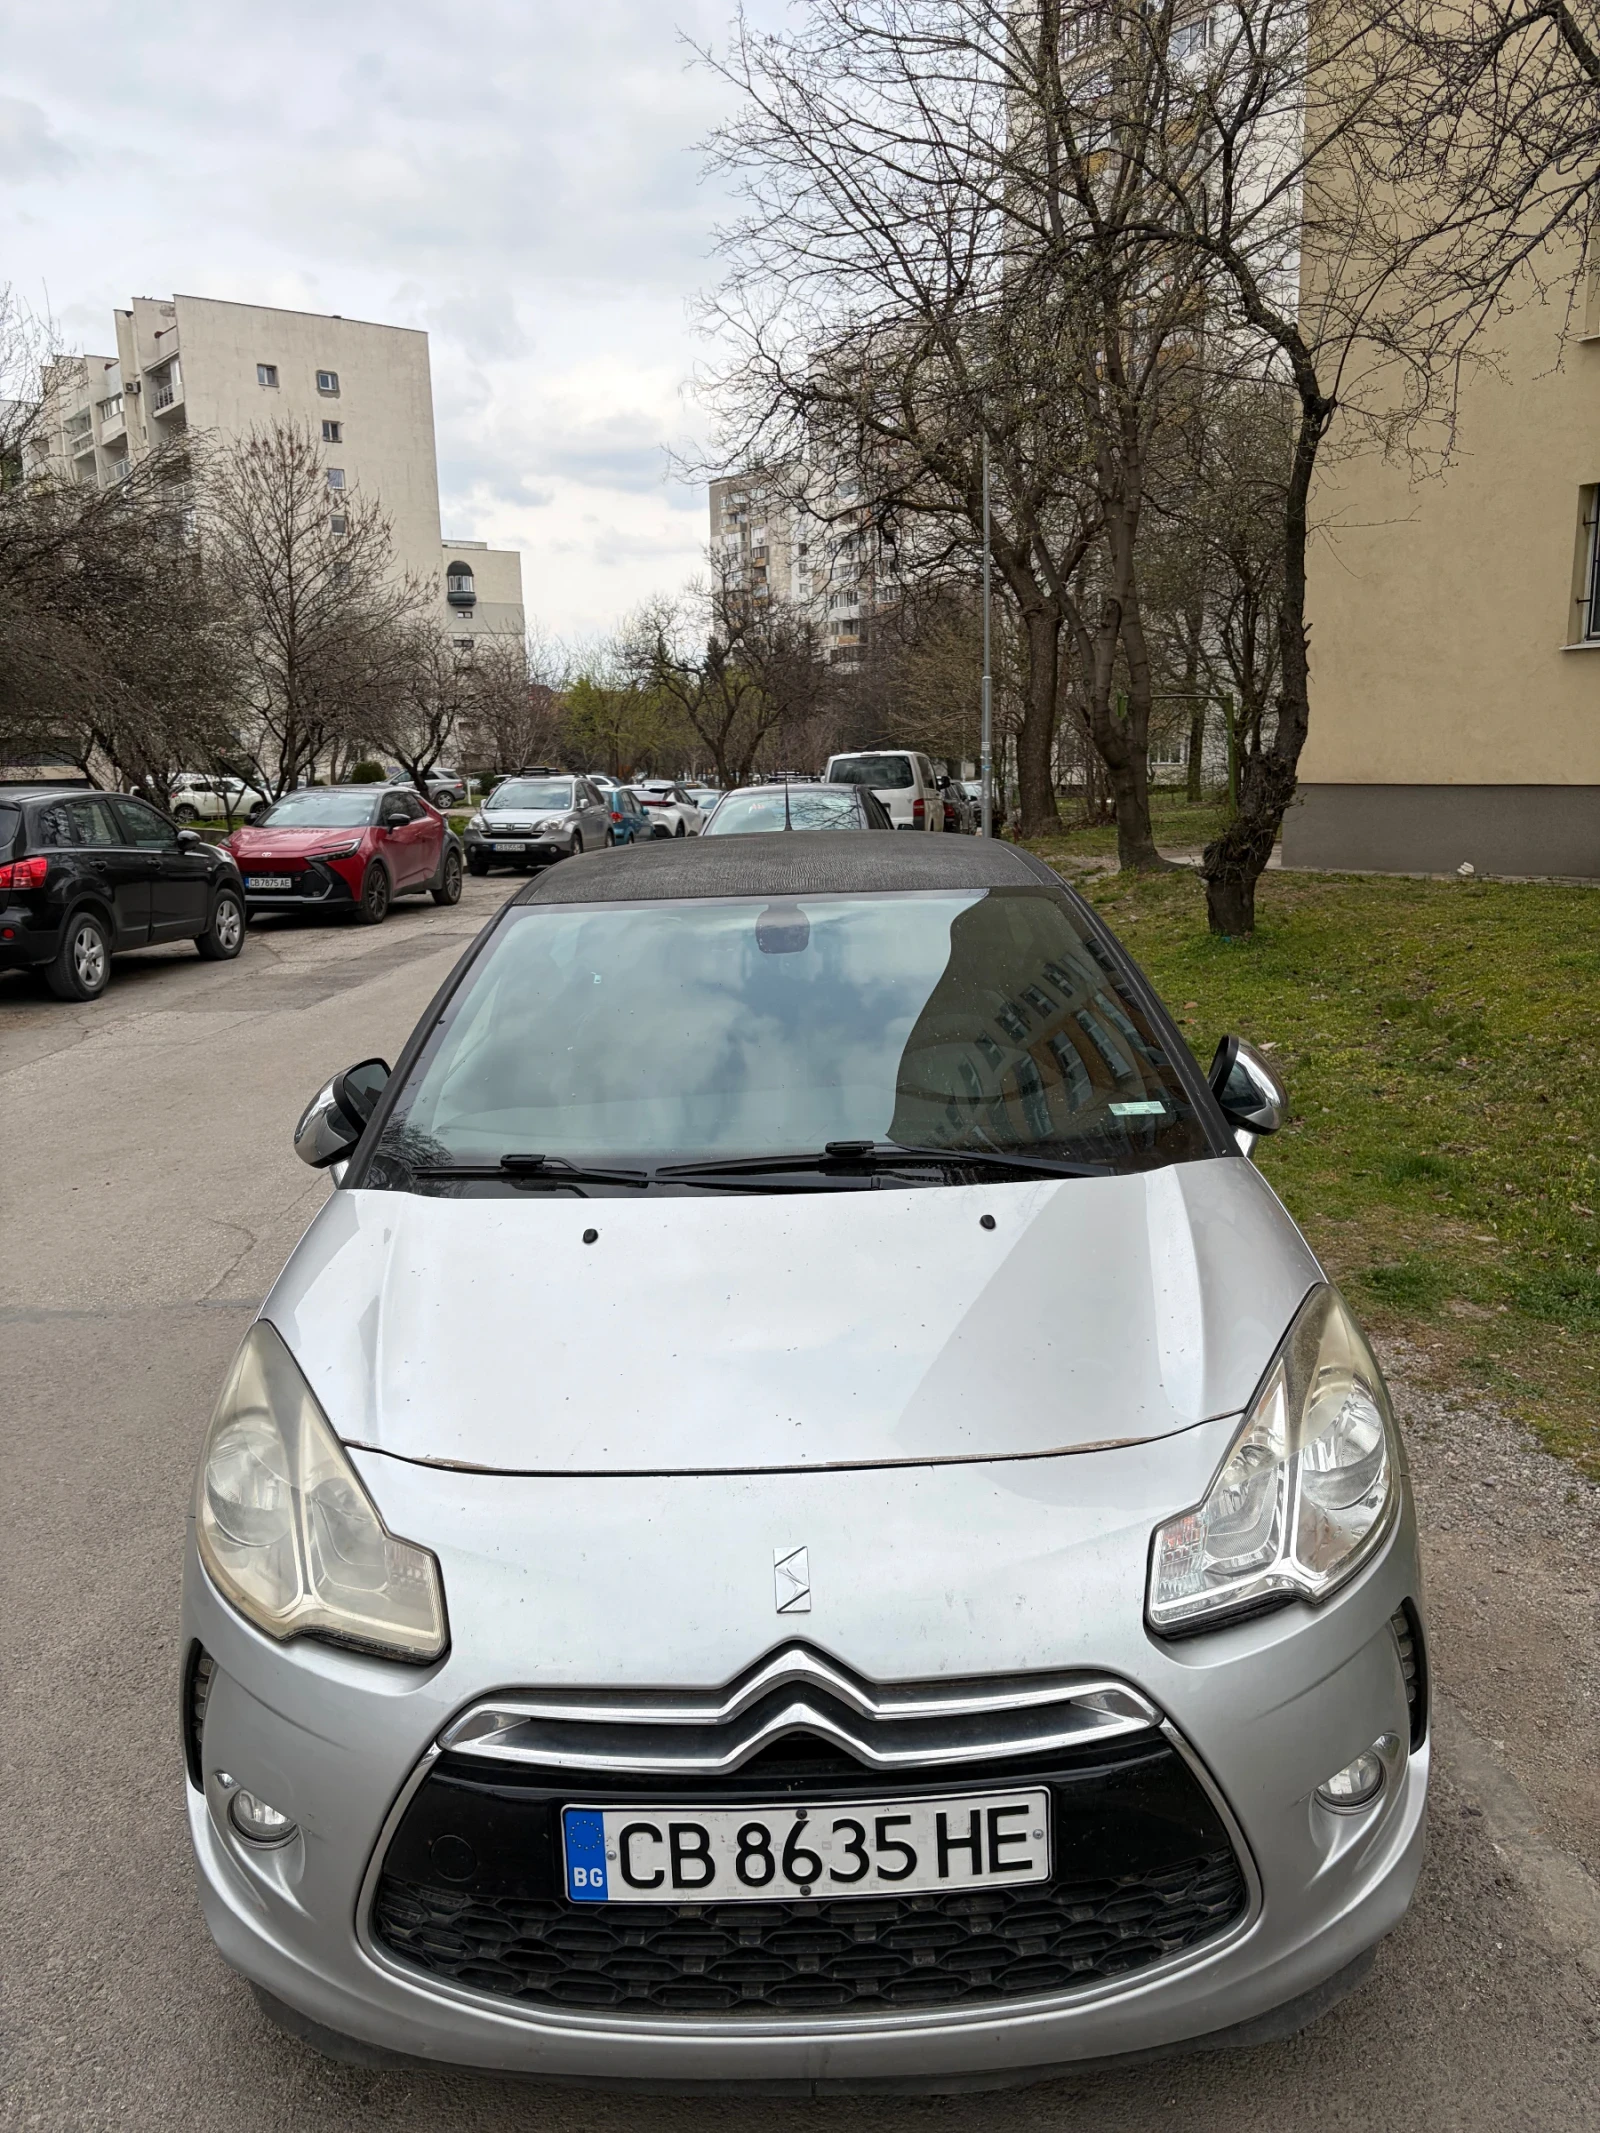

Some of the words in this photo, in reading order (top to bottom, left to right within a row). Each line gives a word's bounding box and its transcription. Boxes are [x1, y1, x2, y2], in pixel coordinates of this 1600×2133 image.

[250, 879, 260, 887] CB
[280, 879, 290, 887] AE
[619, 1822, 716, 1889] CB
[735, 1814, 918, 1887] 8635
[935, 1804, 1033, 1878] HE
[573, 1866, 604, 1888] BG
